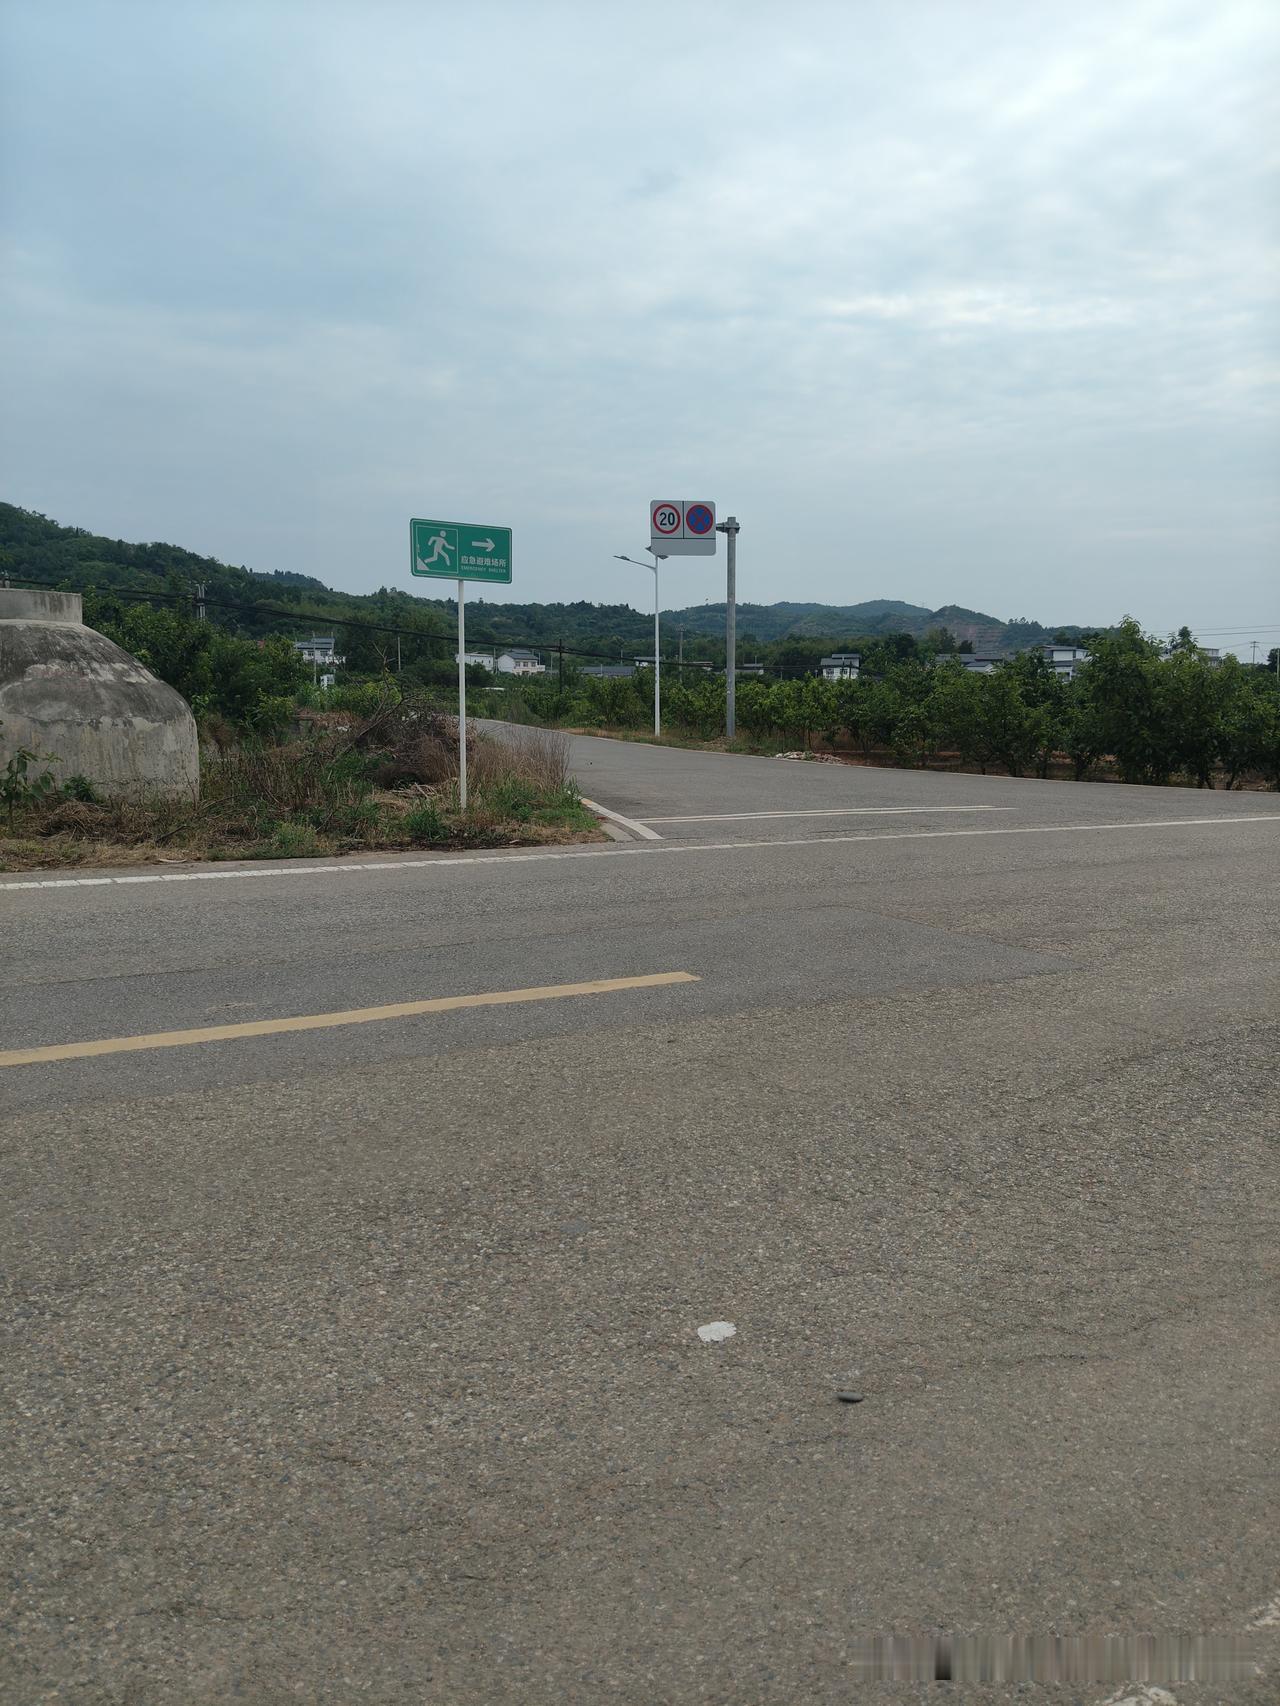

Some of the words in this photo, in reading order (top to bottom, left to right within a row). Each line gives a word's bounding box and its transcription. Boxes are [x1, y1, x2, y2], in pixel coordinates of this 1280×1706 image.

[659, 512, 675, 526] 20
[461, 555, 506, 567] 应急避难场所
